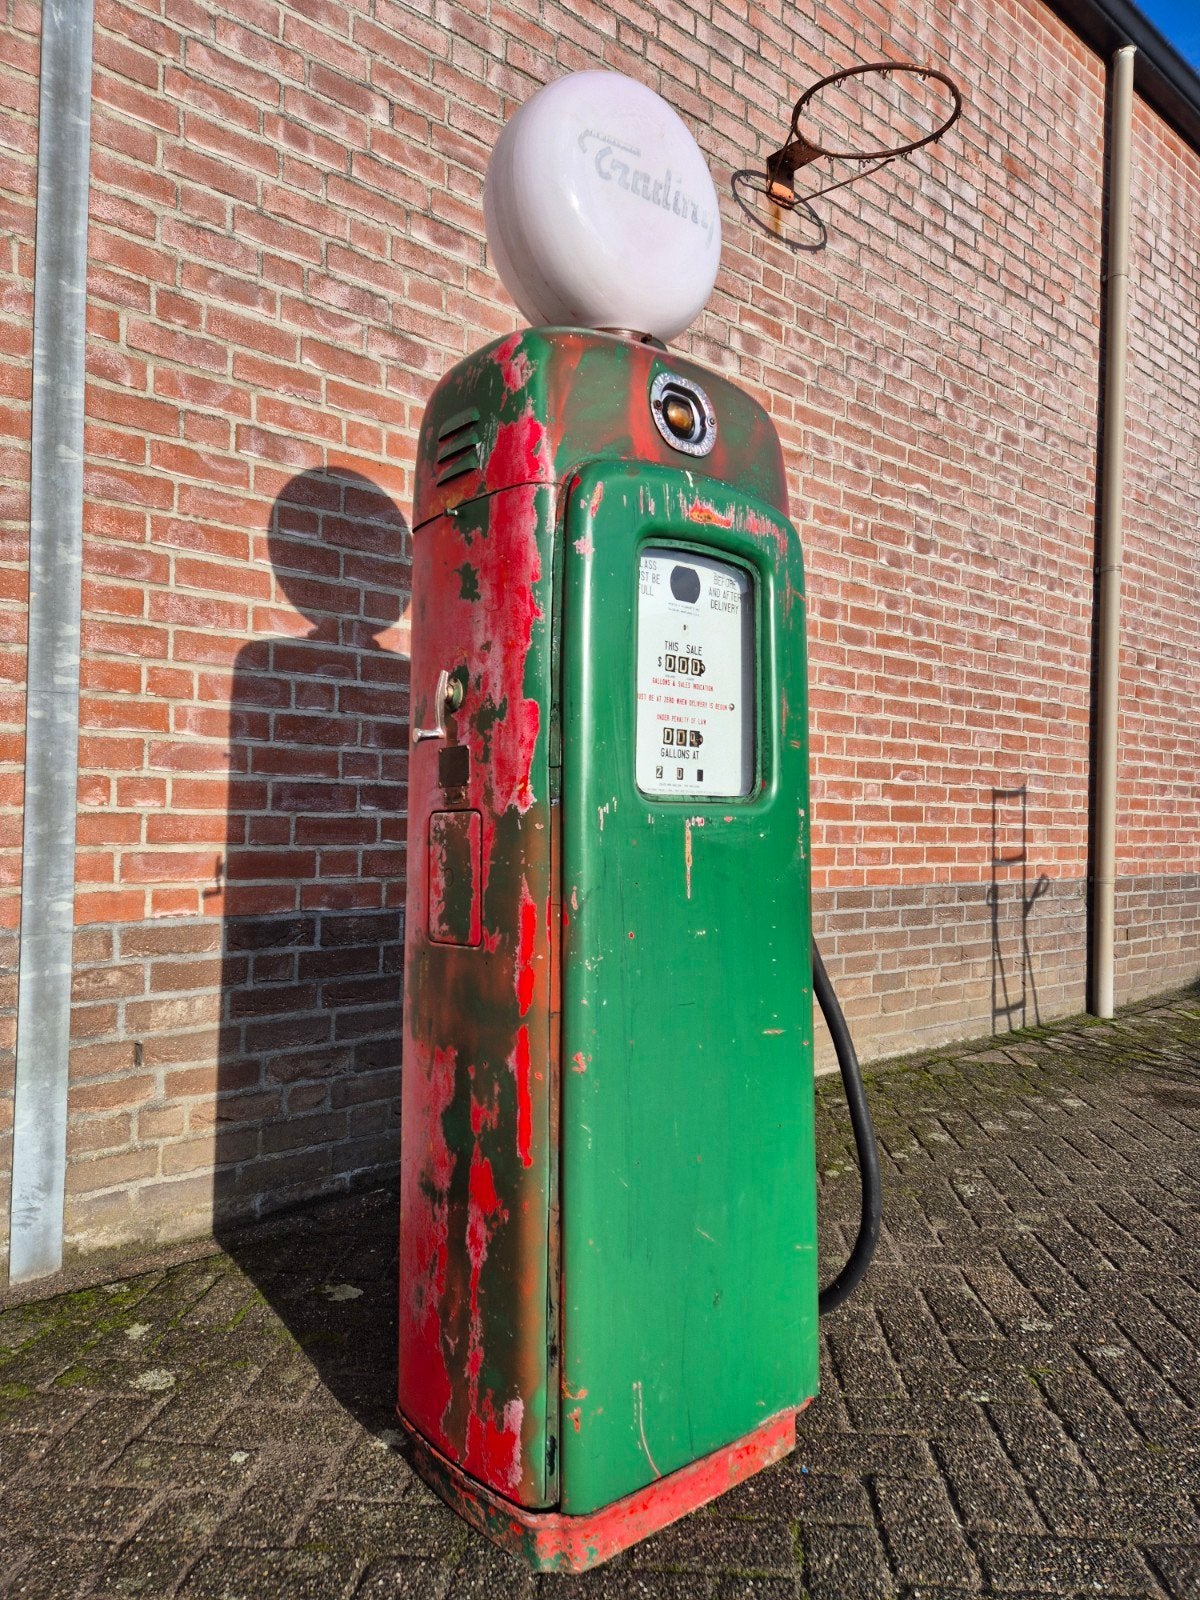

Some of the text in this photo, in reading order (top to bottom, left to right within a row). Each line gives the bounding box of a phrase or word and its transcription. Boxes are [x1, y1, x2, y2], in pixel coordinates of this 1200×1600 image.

[640, 570, 661, 585] ST BE
[713, 575, 737, 590] BEFORE
[639, 583, 654, 597] ULL
[708, 586, 720, 598] AND
[710, 598, 739, 615] DELIVERY
[664, 640, 702, 656] THIS SALE
[652, 676, 671, 687] GALLONS
[678, 680, 691, 689] SALES
[692, 682, 714, 692] INDICATION
[663, 696, 675, 704] ZERO
[676, 697, 687, 706] WHEN
[688, 699, 708, 709] DELIVERY
[656, 713, 670, 722] UNDER
[671, 715, 689, 724] PENALTY
[698, 718, 707, 726] LAW
[660, 747, 700, 761] GALLONS AT
